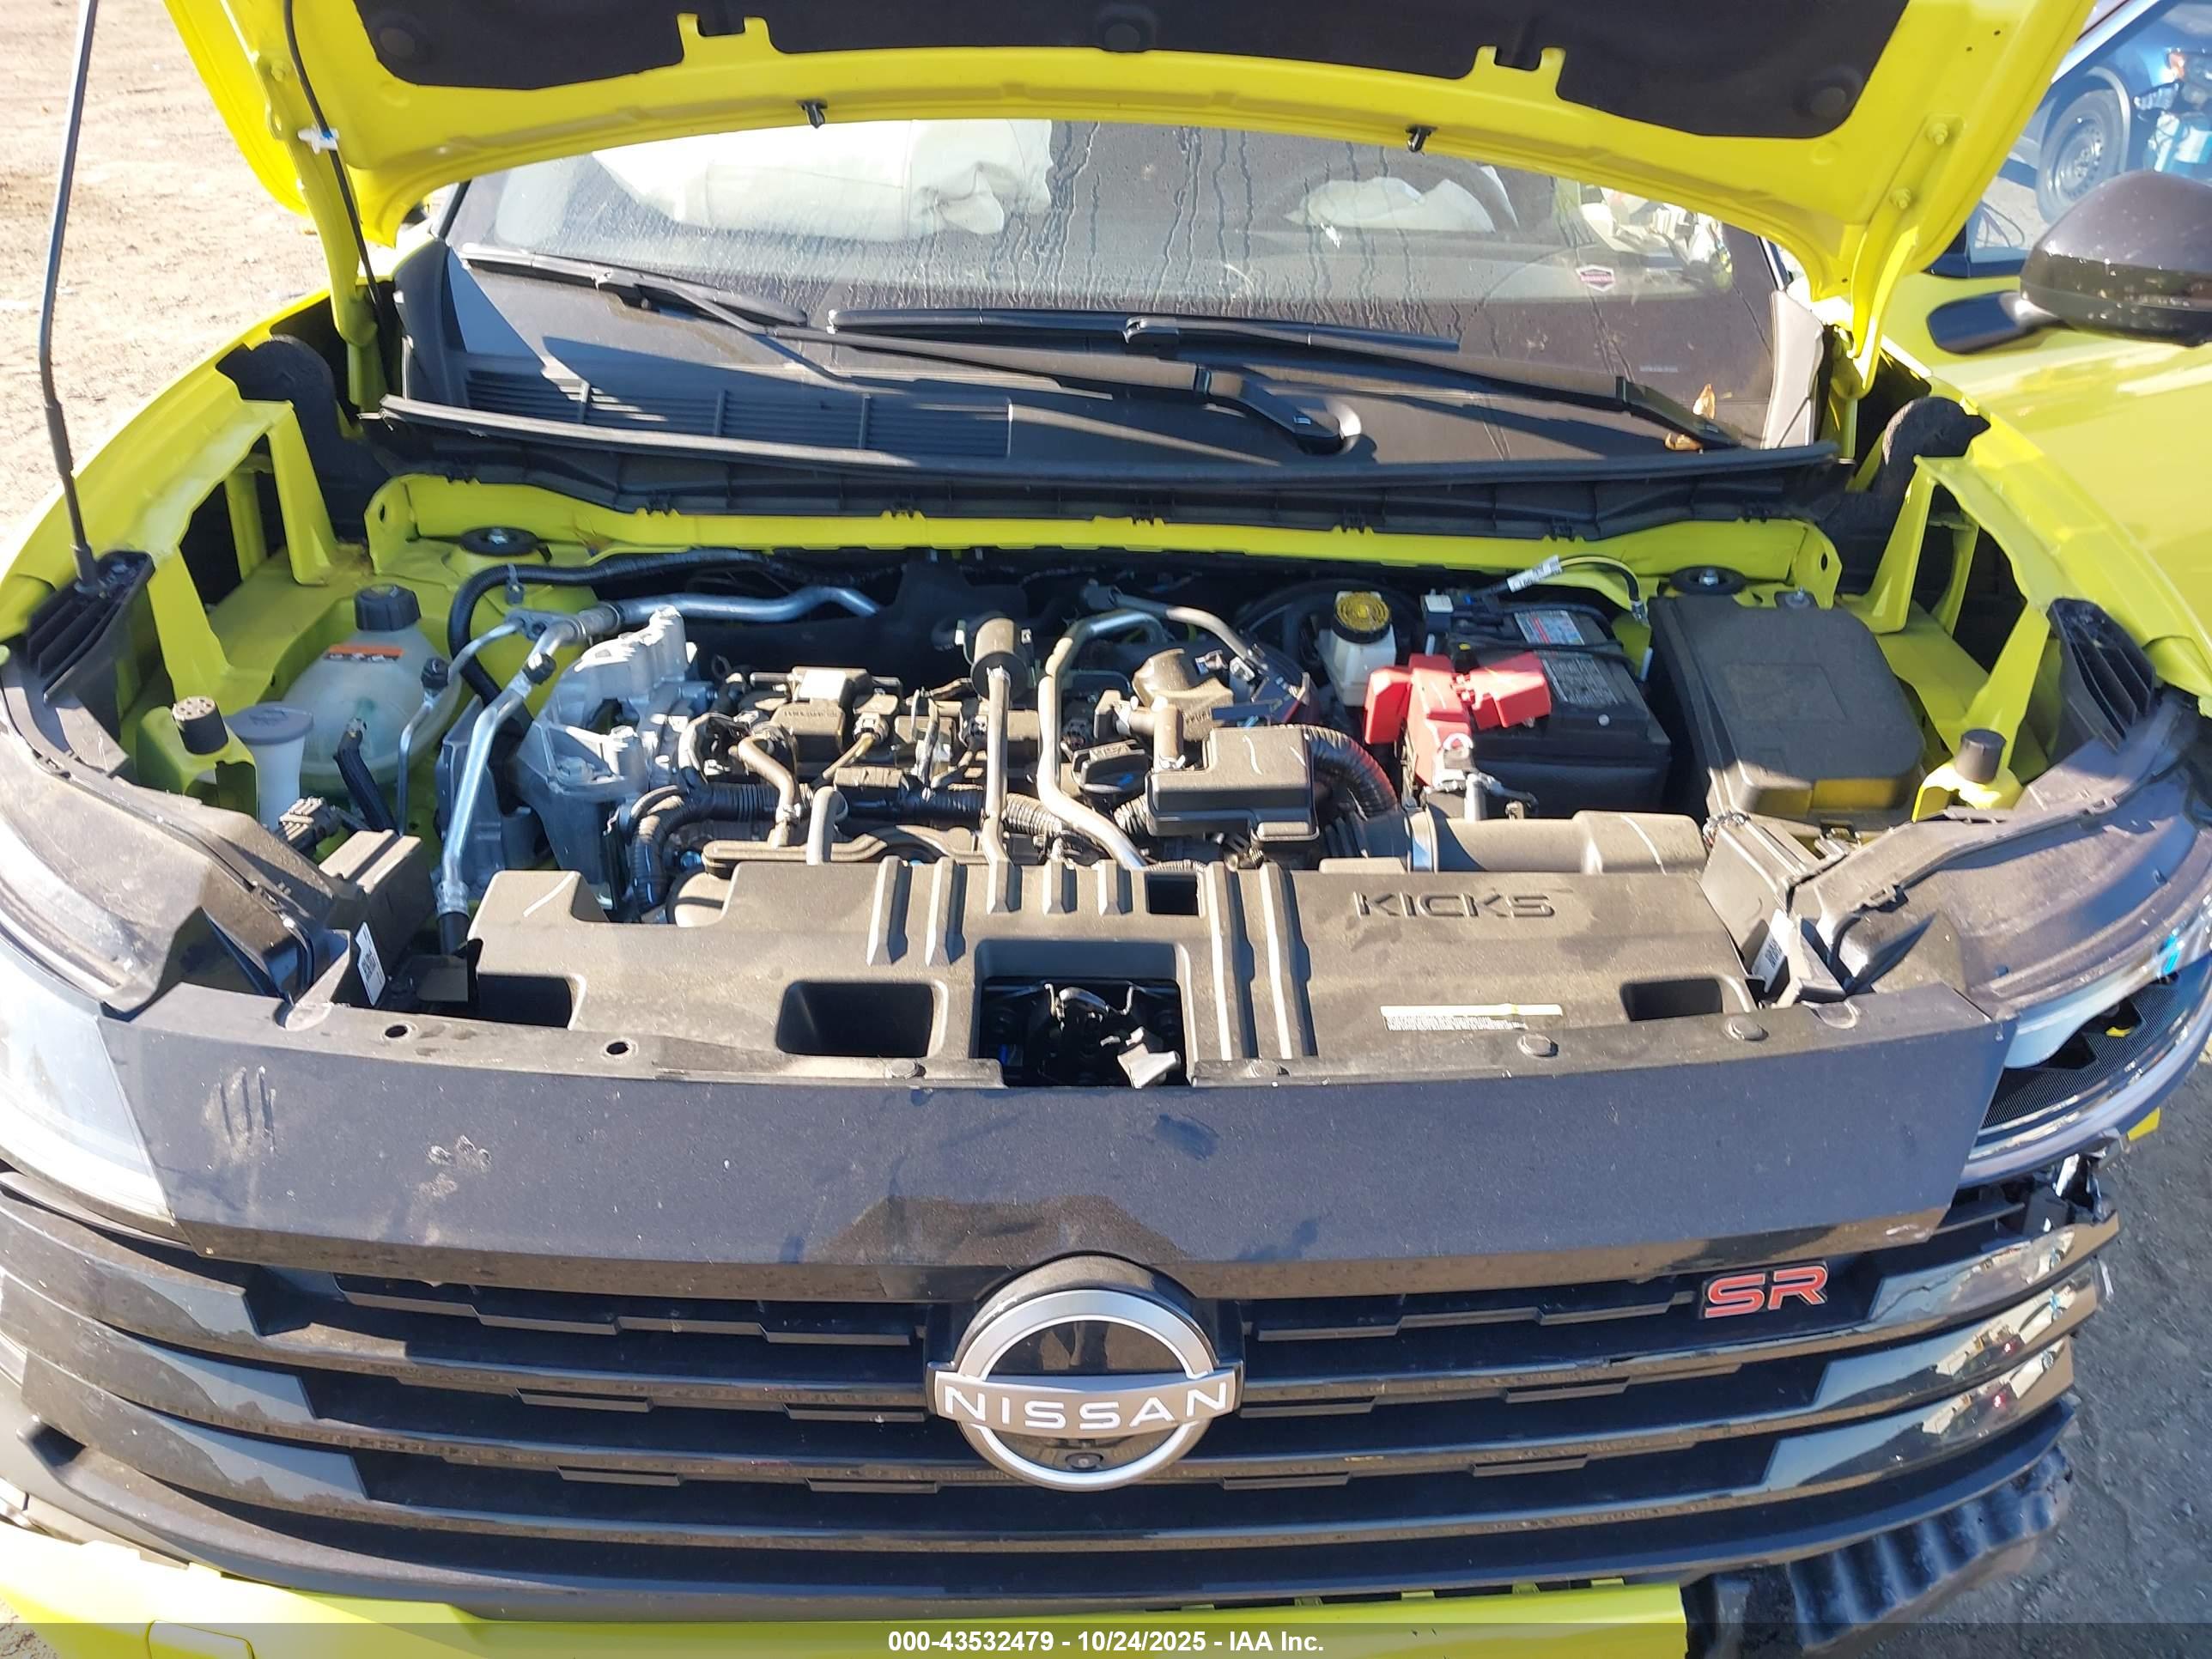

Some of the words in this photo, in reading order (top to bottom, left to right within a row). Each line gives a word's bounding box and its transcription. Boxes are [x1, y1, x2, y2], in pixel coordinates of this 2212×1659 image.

[1352, 890, 1555, 920] KICKS
[1704, 1266, 1828, 1319] SR
[944, 1381, 1226, 1431] NISSAN
